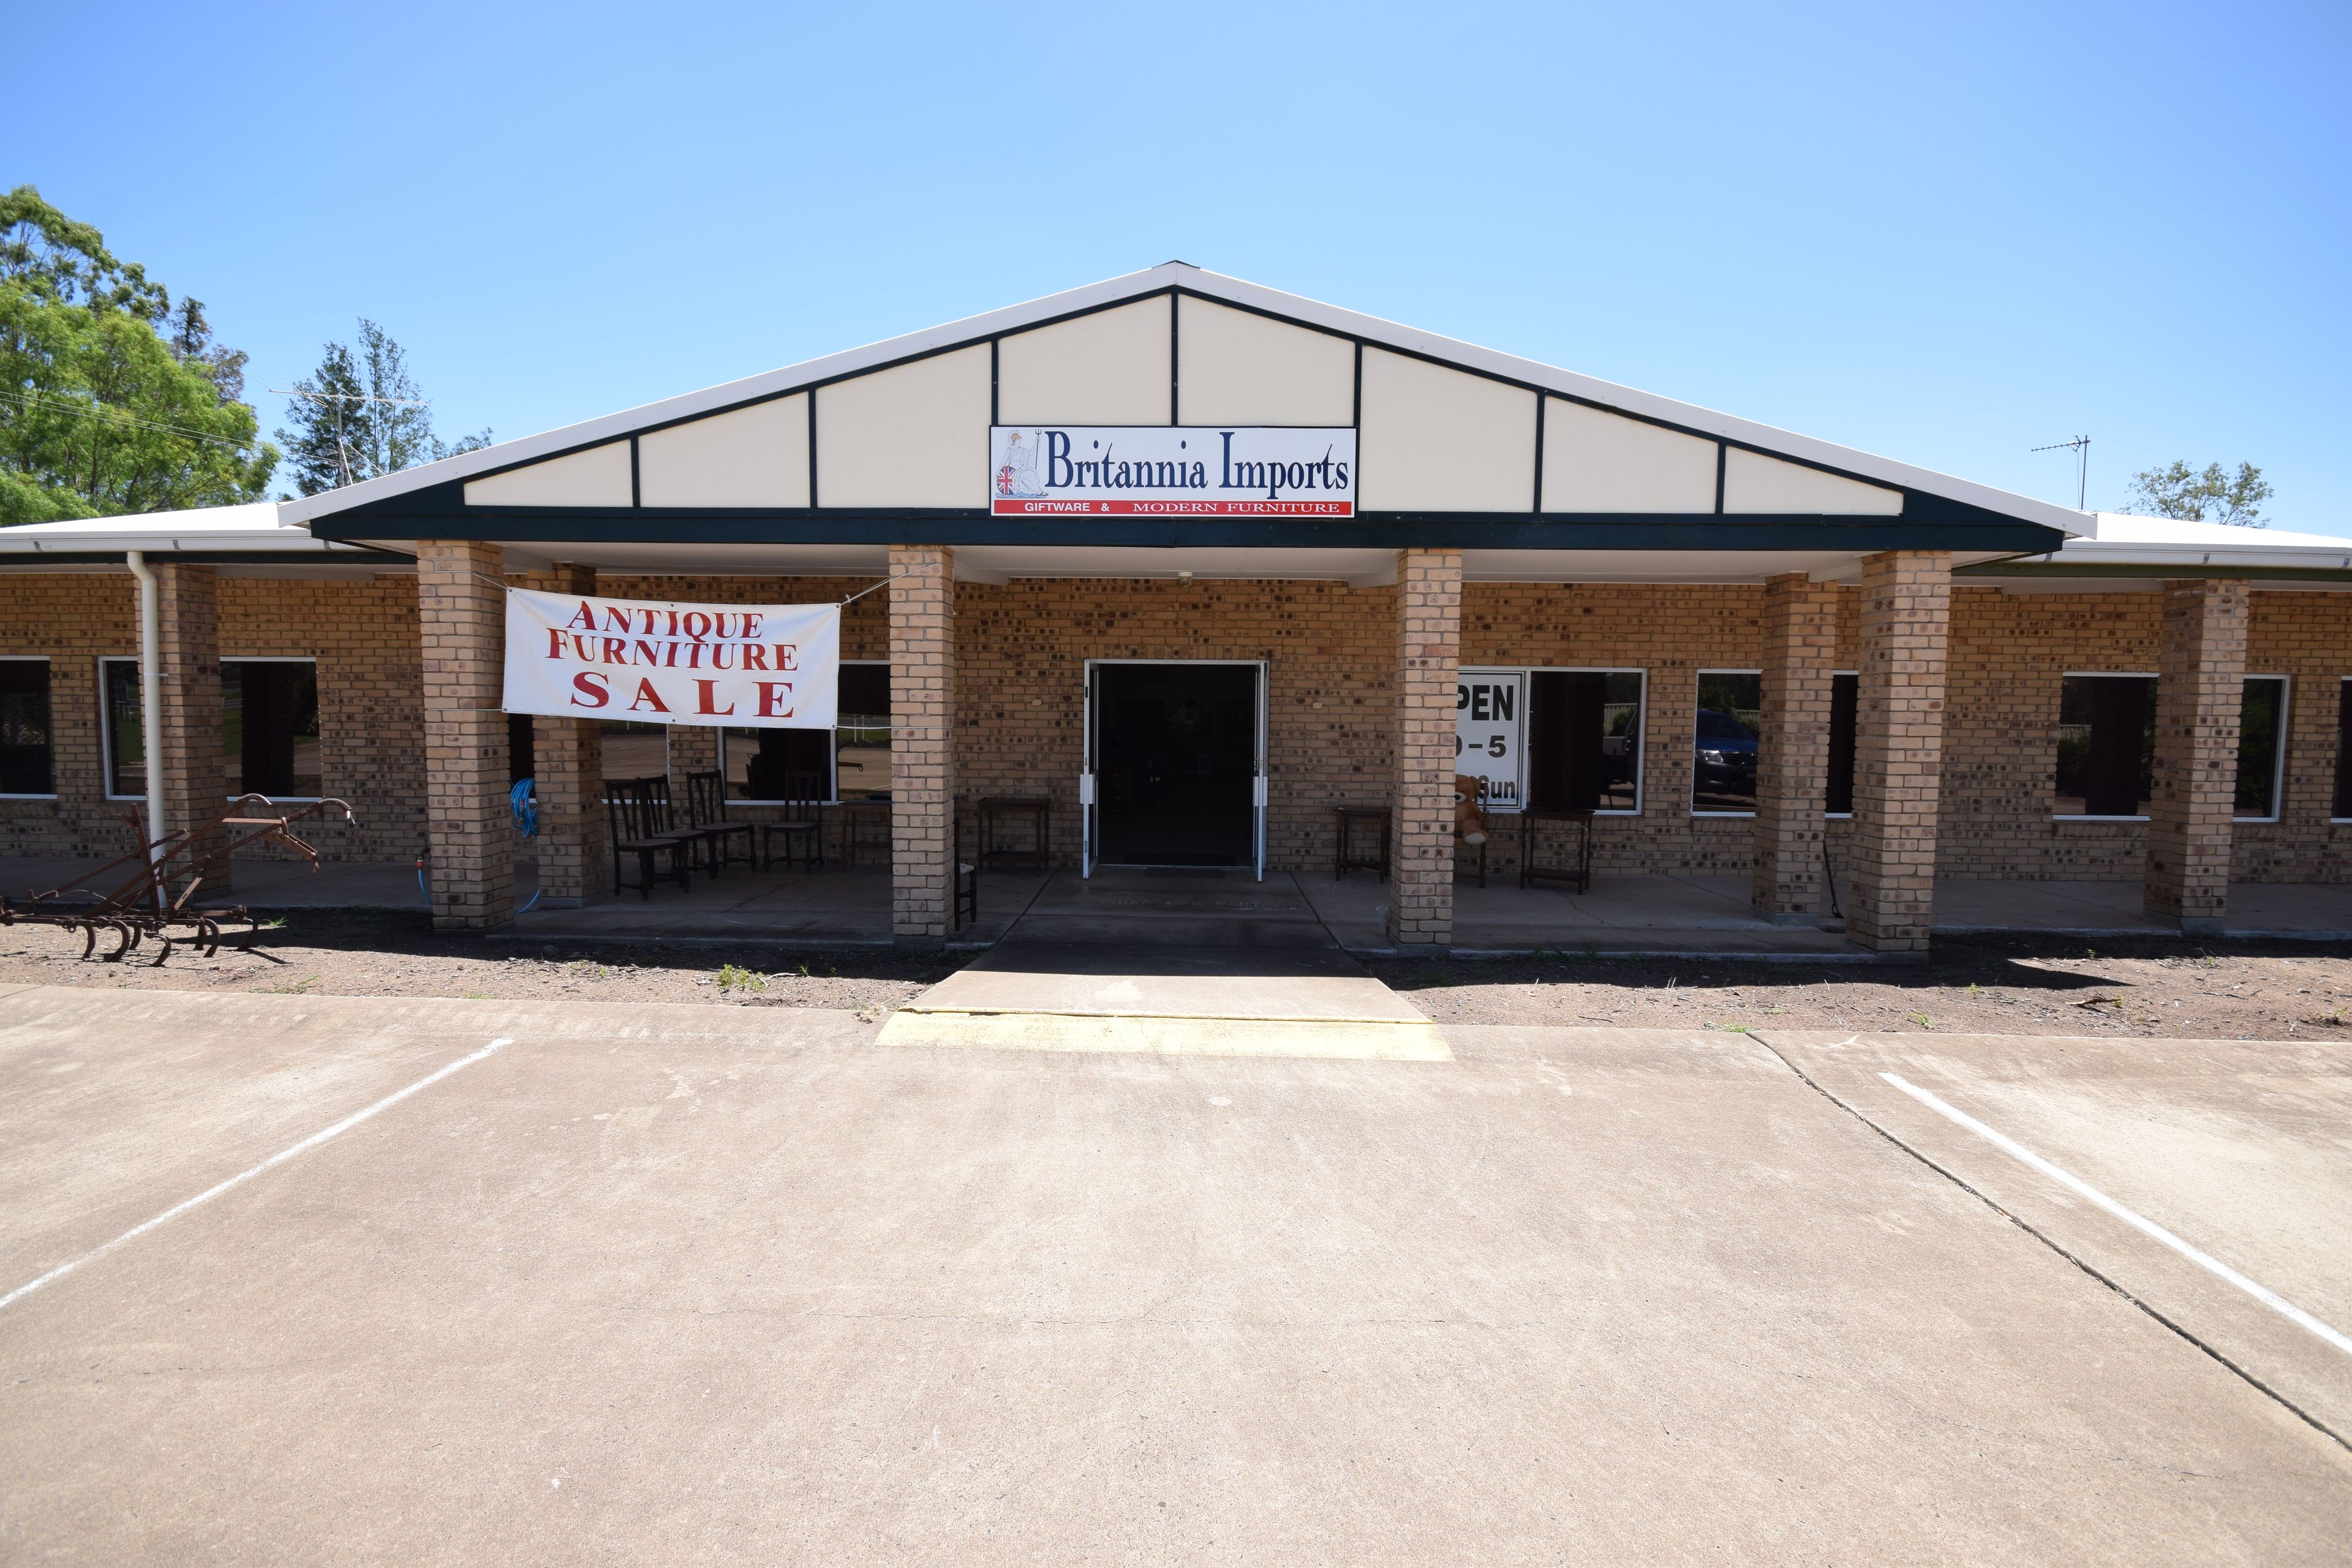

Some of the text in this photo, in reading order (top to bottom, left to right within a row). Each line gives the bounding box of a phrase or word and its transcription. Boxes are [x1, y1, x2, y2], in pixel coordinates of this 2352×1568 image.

[1044, 430, 1349, 500] Britannia Imports
[1024, 502, 1340, 513] GIFTWARE & MODERN FURNITURE
[565, 600, 763, 642] ANTIQUE
[545, 627, 799, 671] FURNITURE
[570, 671, 794, 718] SALE
